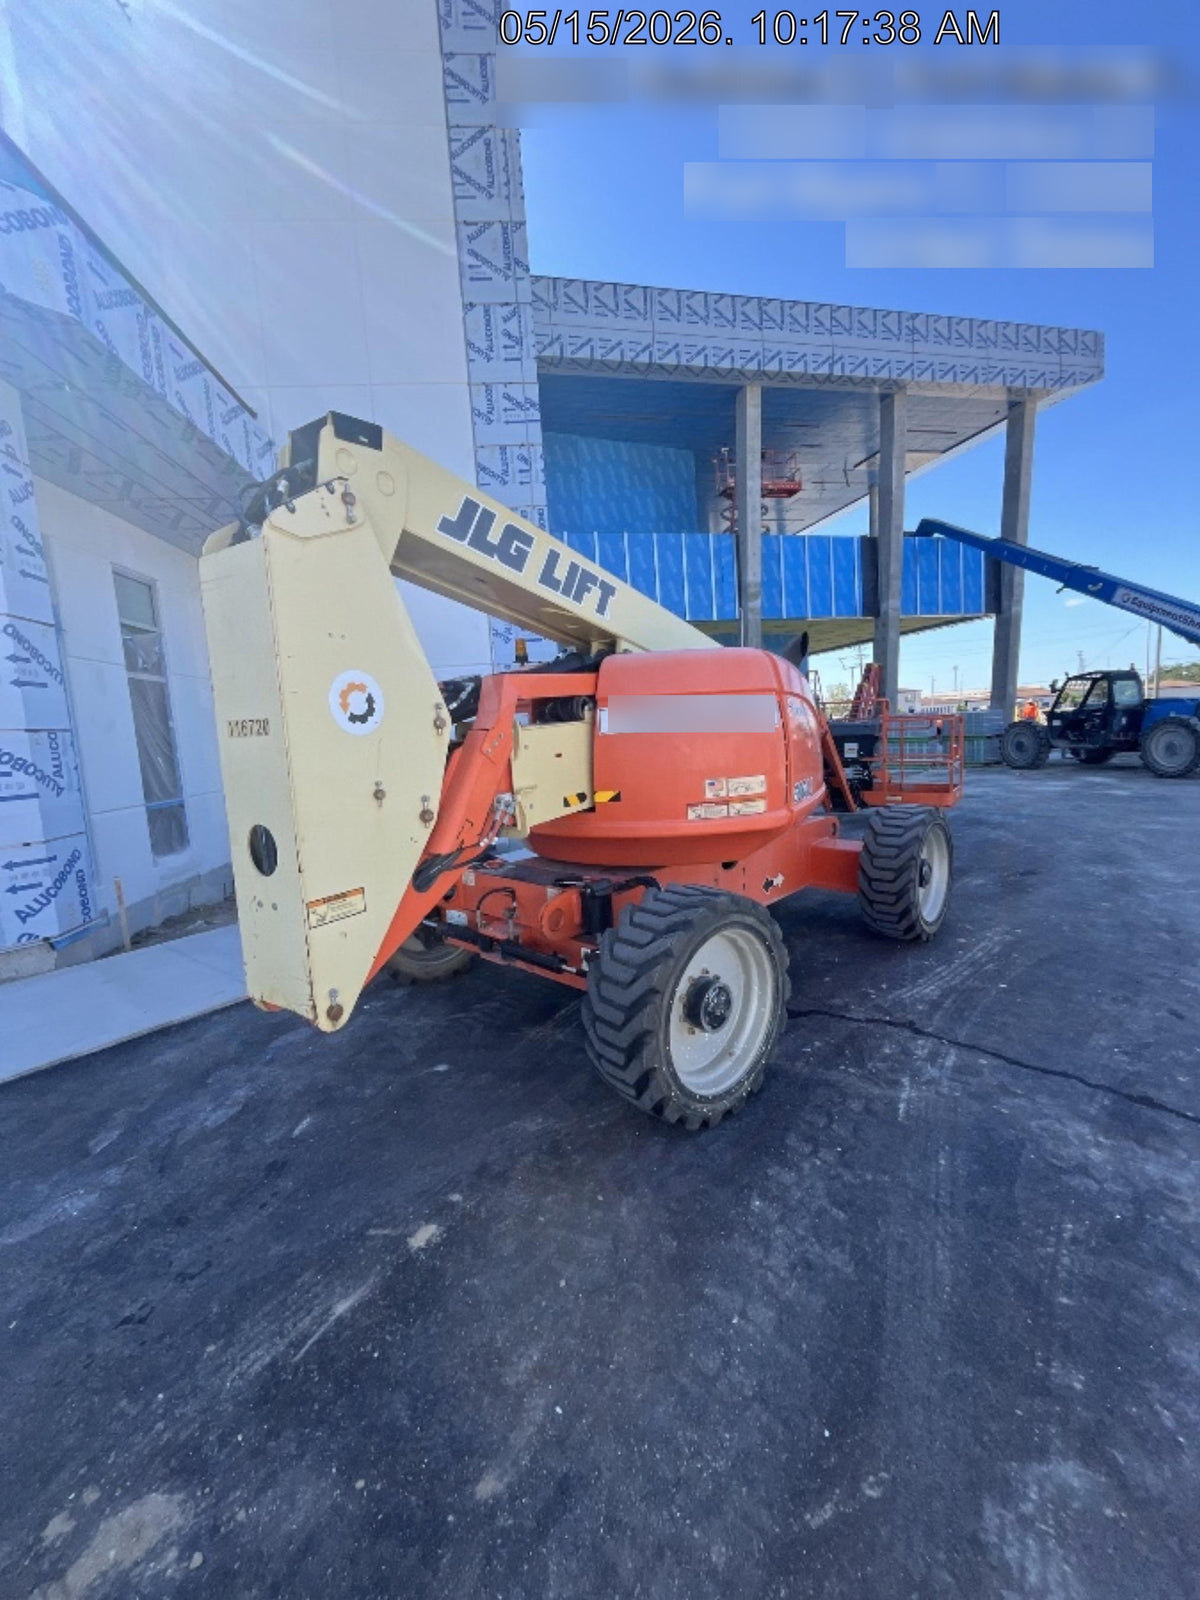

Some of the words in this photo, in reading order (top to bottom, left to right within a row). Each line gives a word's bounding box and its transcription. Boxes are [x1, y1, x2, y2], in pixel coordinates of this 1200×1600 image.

[436, 495, 536, 575] JLG
[537, 547, 616, 619] LIFT
[14, 849, 81, 925] ALUCOBOND
